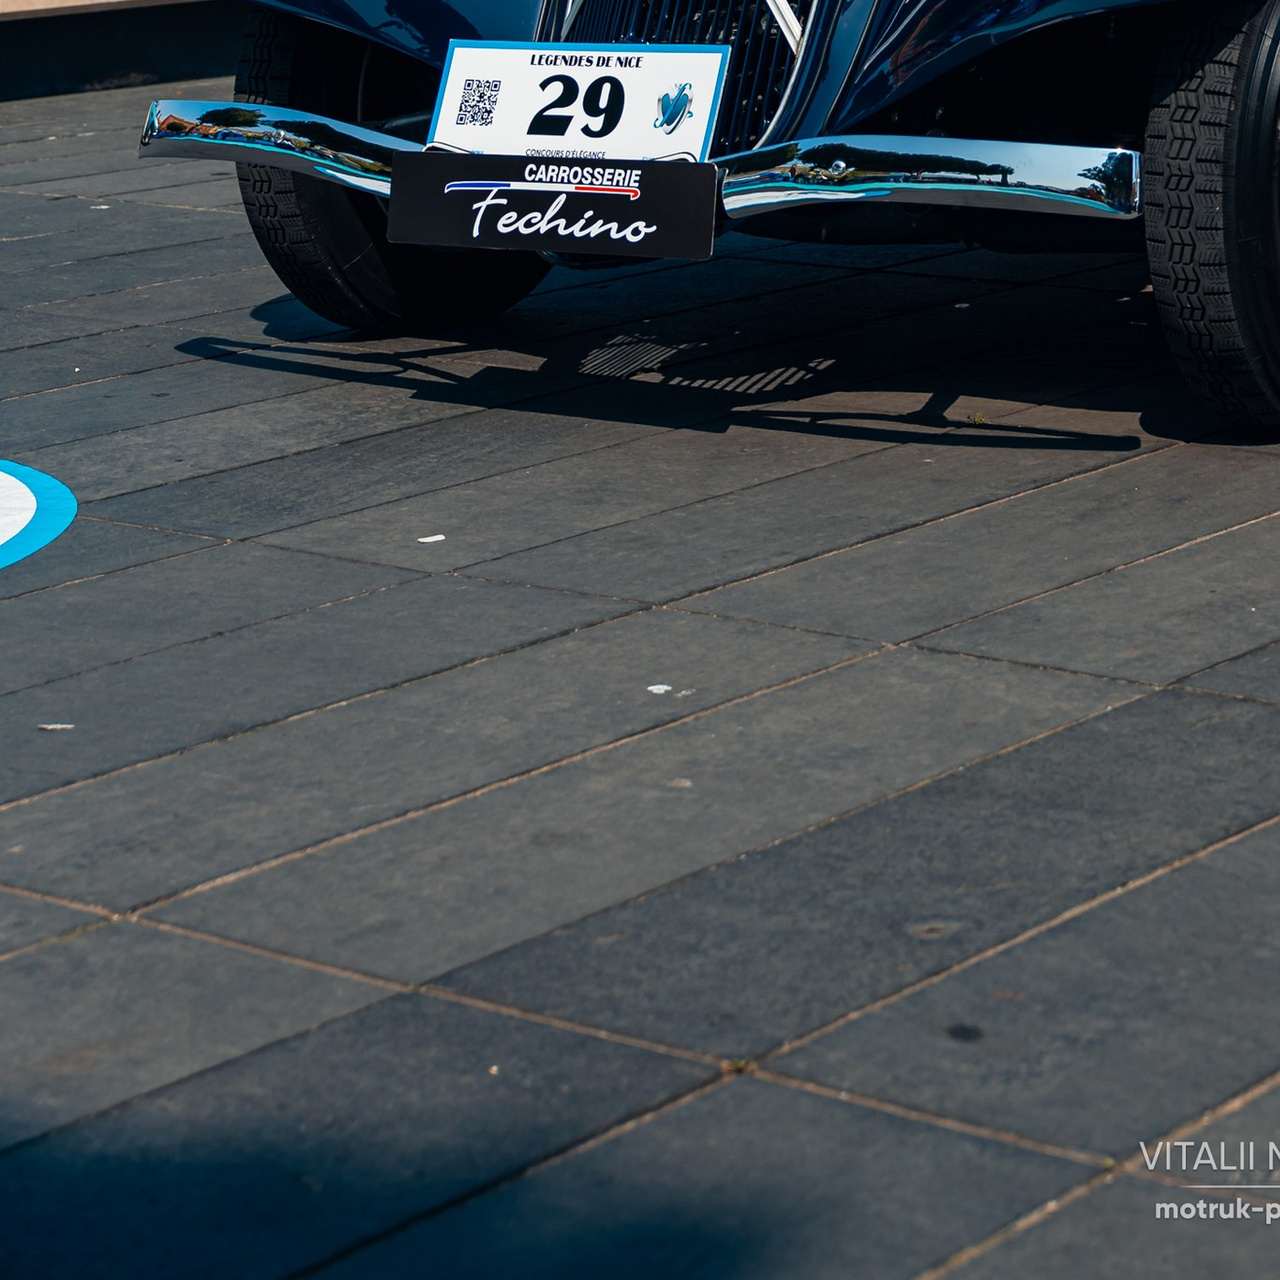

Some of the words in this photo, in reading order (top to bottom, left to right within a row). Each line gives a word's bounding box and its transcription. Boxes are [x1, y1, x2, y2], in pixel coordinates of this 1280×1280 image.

[530, 53, 594, 67] LEGENDES
[595, 55, 613, 68] DE
[614, 55, 644, 69] NICE
[526, 73, 626, 139] 29
[525, 148, 564, 158] CONCOURS
[524, 163, 642, 188] CARROSSERIE
